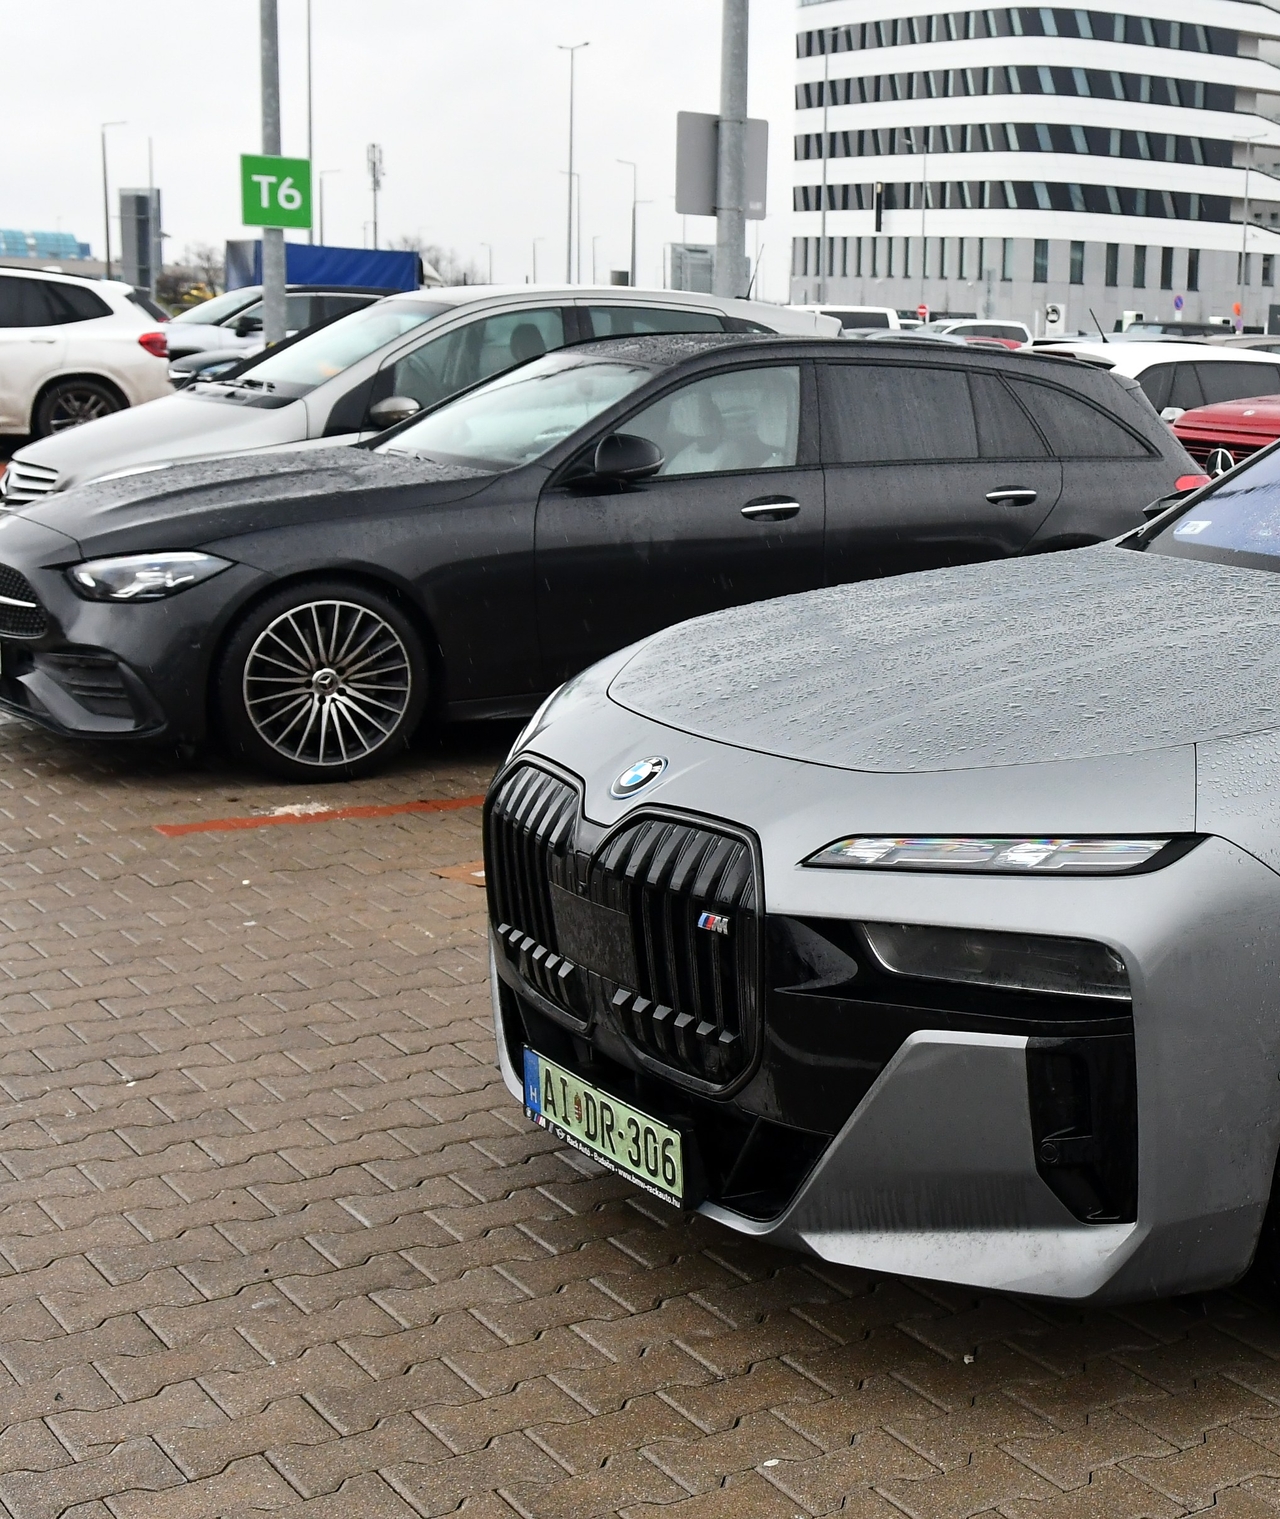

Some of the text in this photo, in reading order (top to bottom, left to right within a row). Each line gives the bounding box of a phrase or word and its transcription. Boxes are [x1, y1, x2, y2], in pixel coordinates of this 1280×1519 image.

[251, 174, 303, 210] T6
[529, 1084, 538, 1104] H
[544, 1067, 571, 1126] AI
[566, 1134, 579, 1149] Rack
